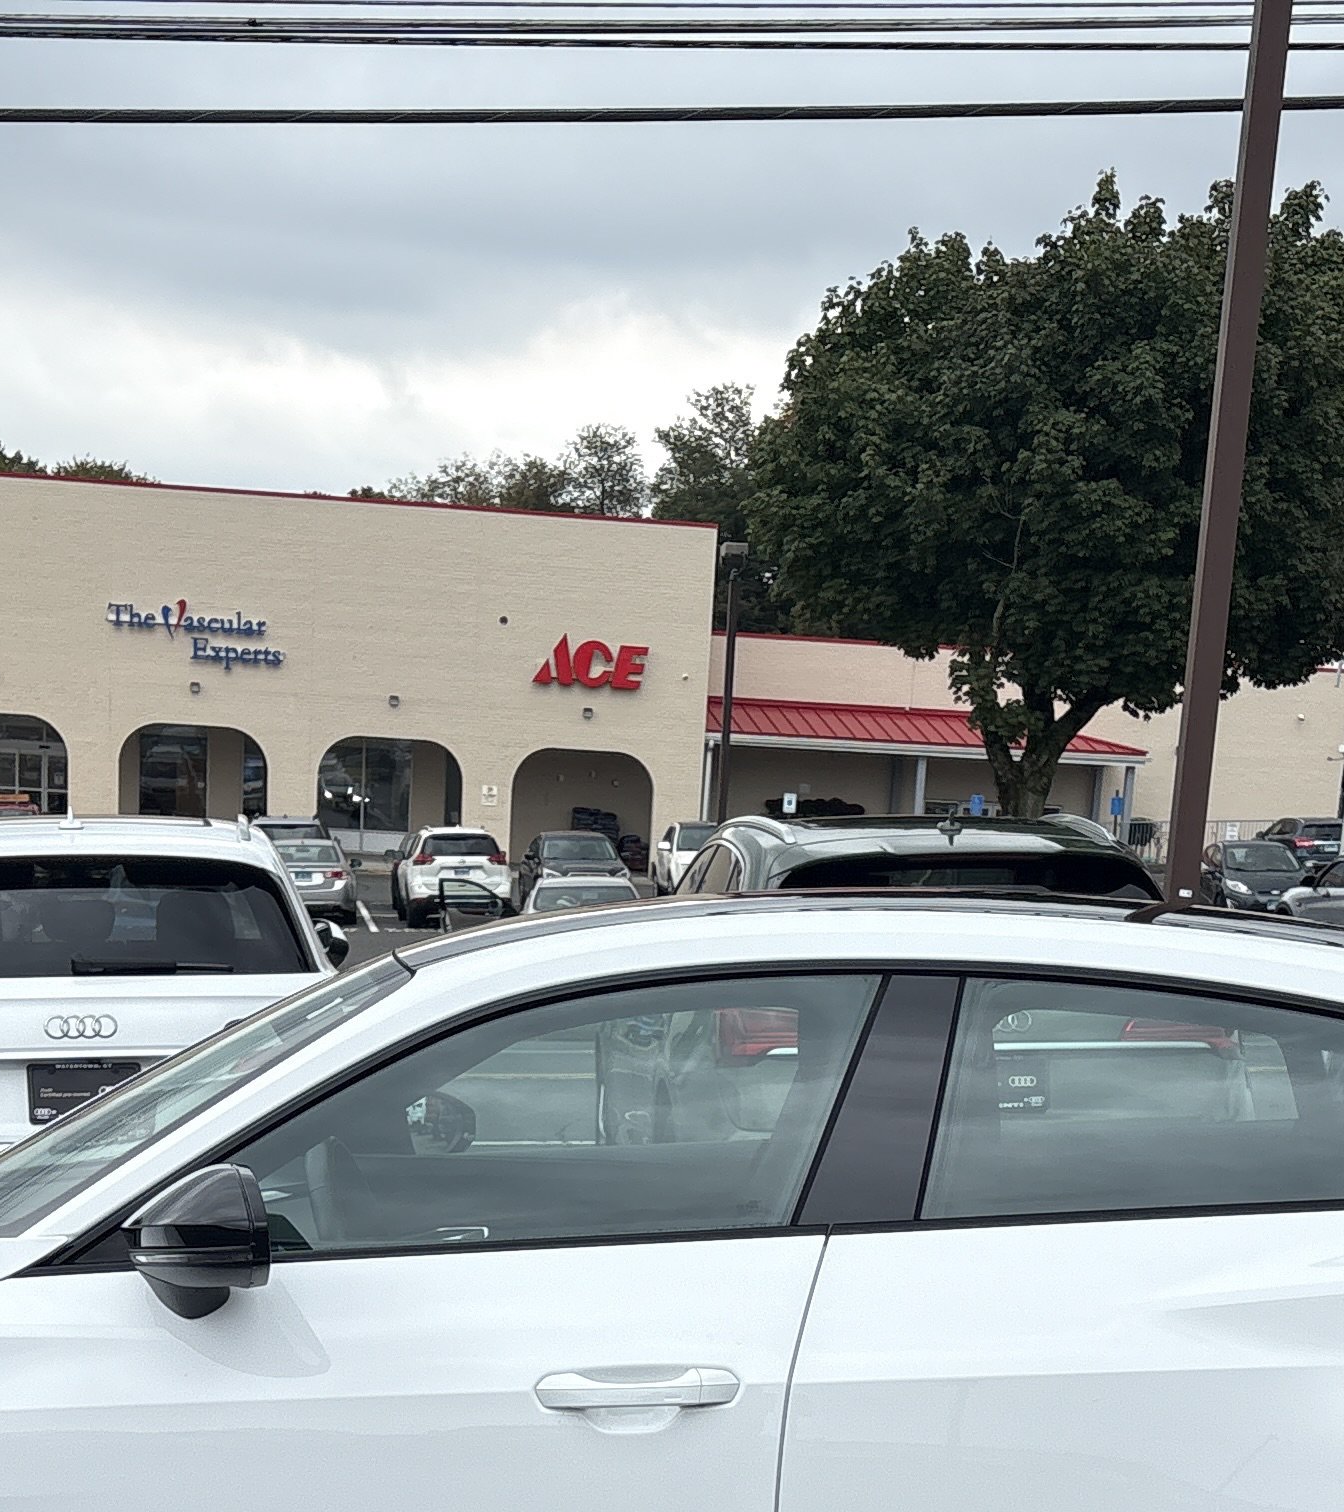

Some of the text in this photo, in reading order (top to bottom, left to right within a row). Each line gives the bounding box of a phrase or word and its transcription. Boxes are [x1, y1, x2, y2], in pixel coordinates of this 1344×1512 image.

[107, 598, 268, 640] The Vascular
[190, 636, 285, 671] Experts
[531, 632, 650, 691] ACE
